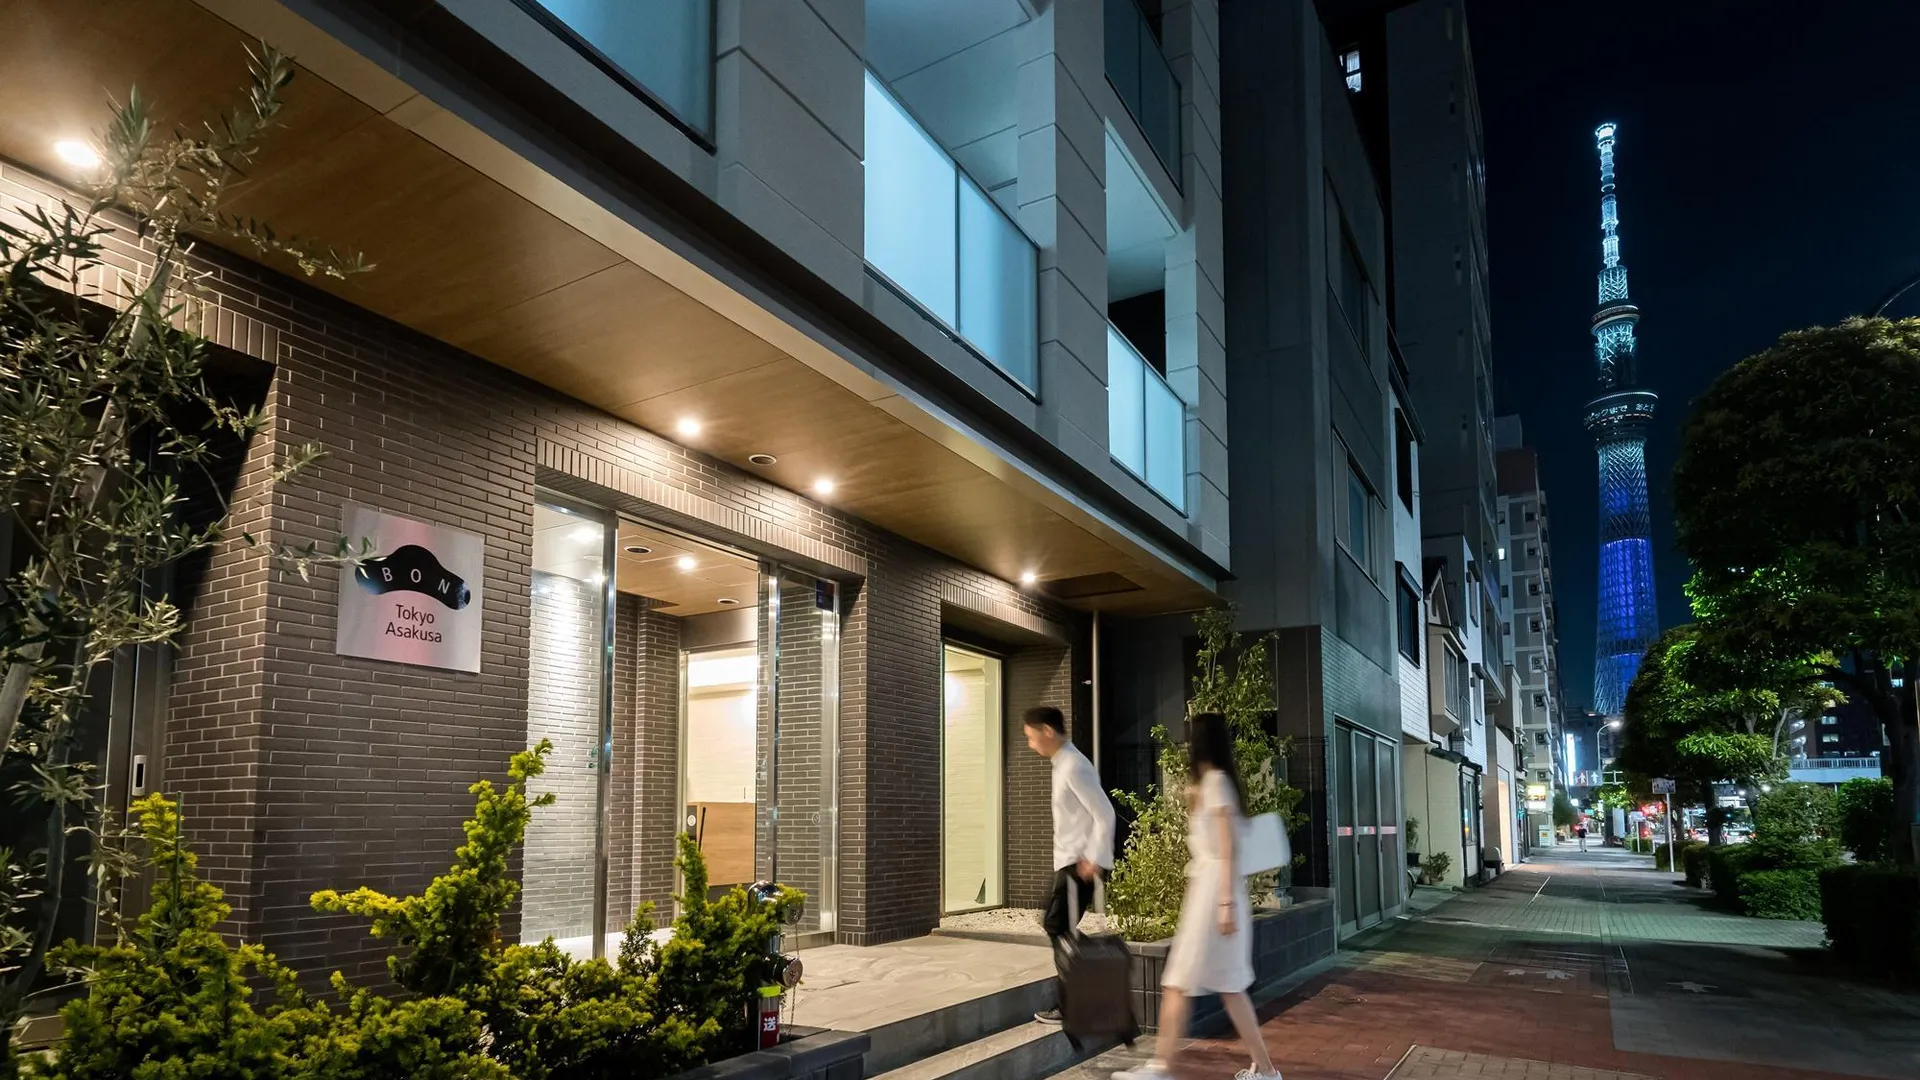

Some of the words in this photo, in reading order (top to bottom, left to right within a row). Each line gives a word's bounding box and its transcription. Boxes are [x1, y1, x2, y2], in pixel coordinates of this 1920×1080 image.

[381, 566, 451, 594] BON
[395, 603, 435, 626] Tokyo
[385, 621, 442, 643] Asakusa
[763, 1016, 777, 1032] 送
